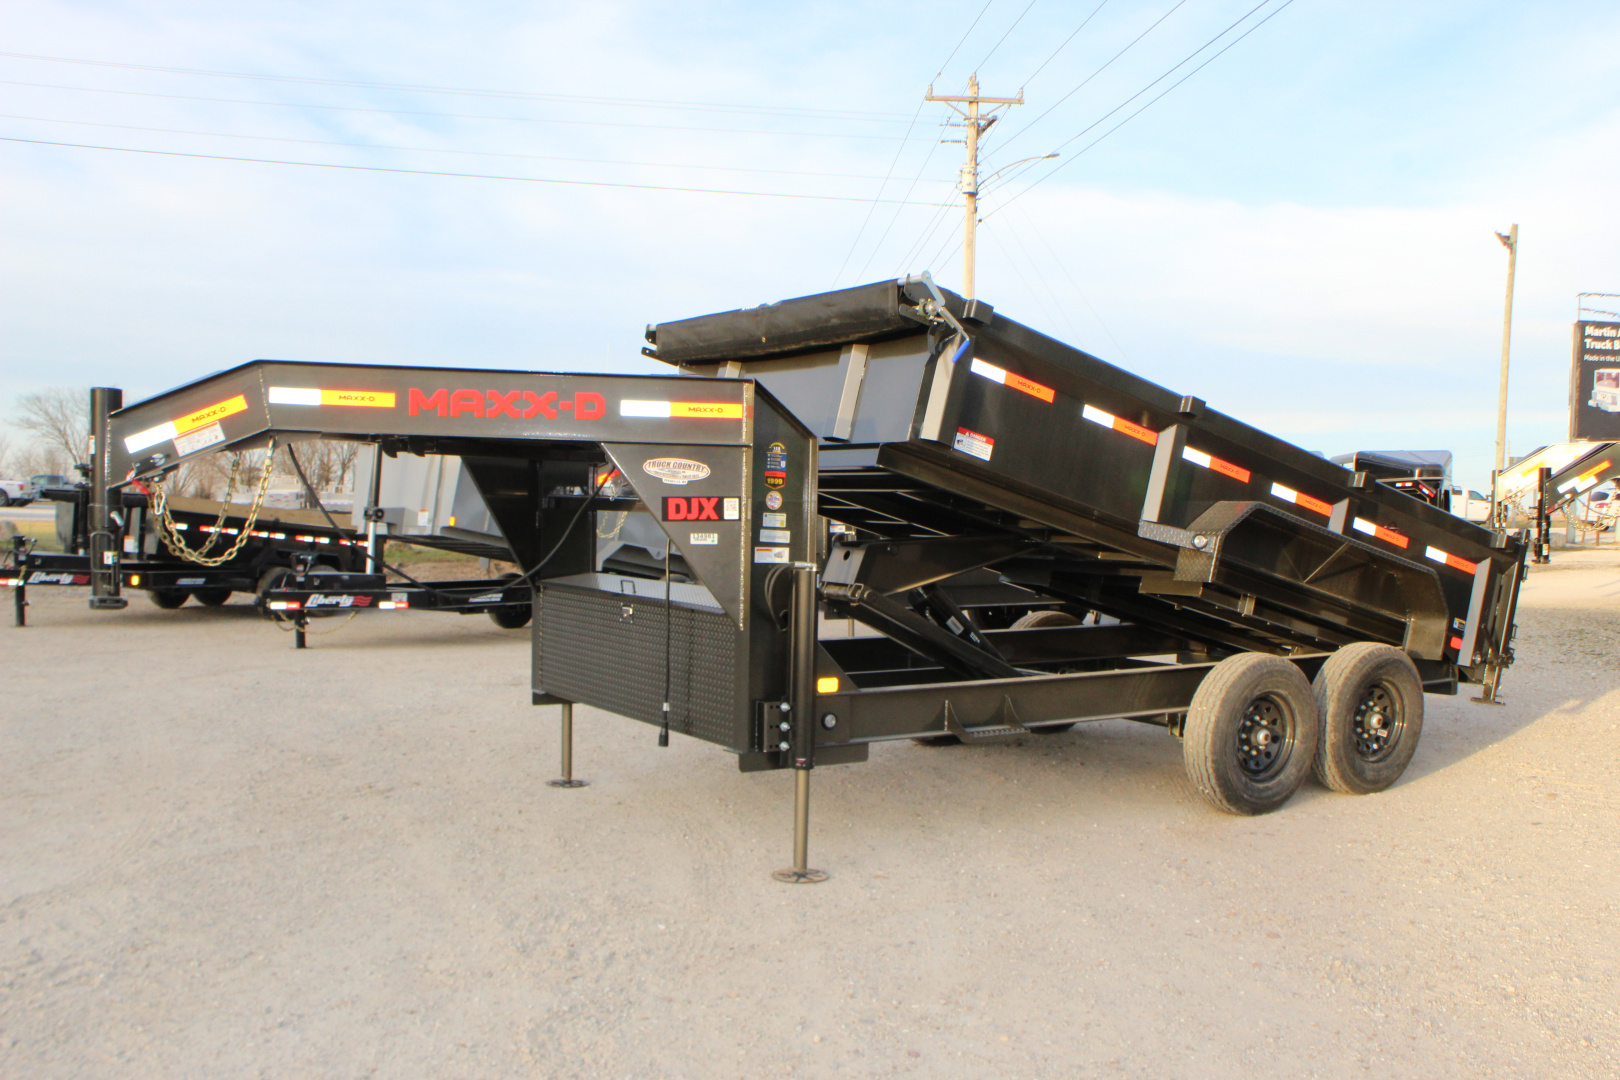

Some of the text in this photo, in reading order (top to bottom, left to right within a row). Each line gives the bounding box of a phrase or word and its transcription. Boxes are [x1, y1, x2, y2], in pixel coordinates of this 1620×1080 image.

[1584, 325, 1617, 337] Martin
[1584, 338, 1613, 350] Truck
[1017, 379, 1041, 394] MAXX-D
[338, 394, 375, 402] MAXX-D
[409, 388, 605, 420] MAXX-D
[191, 406, 227, 424] MAXX-D
[688, 406, 724, 414] MAXX-D
[647, 460, 671, 468] TRUCK
[672, 461, 705, 472] COUNTRY
[767, 477, 784, 485] 1999
[667, 497, 720, 520] DJX
[27, 571, 74, 585] Liberty
[304, 593, 355, 607] Liberty
